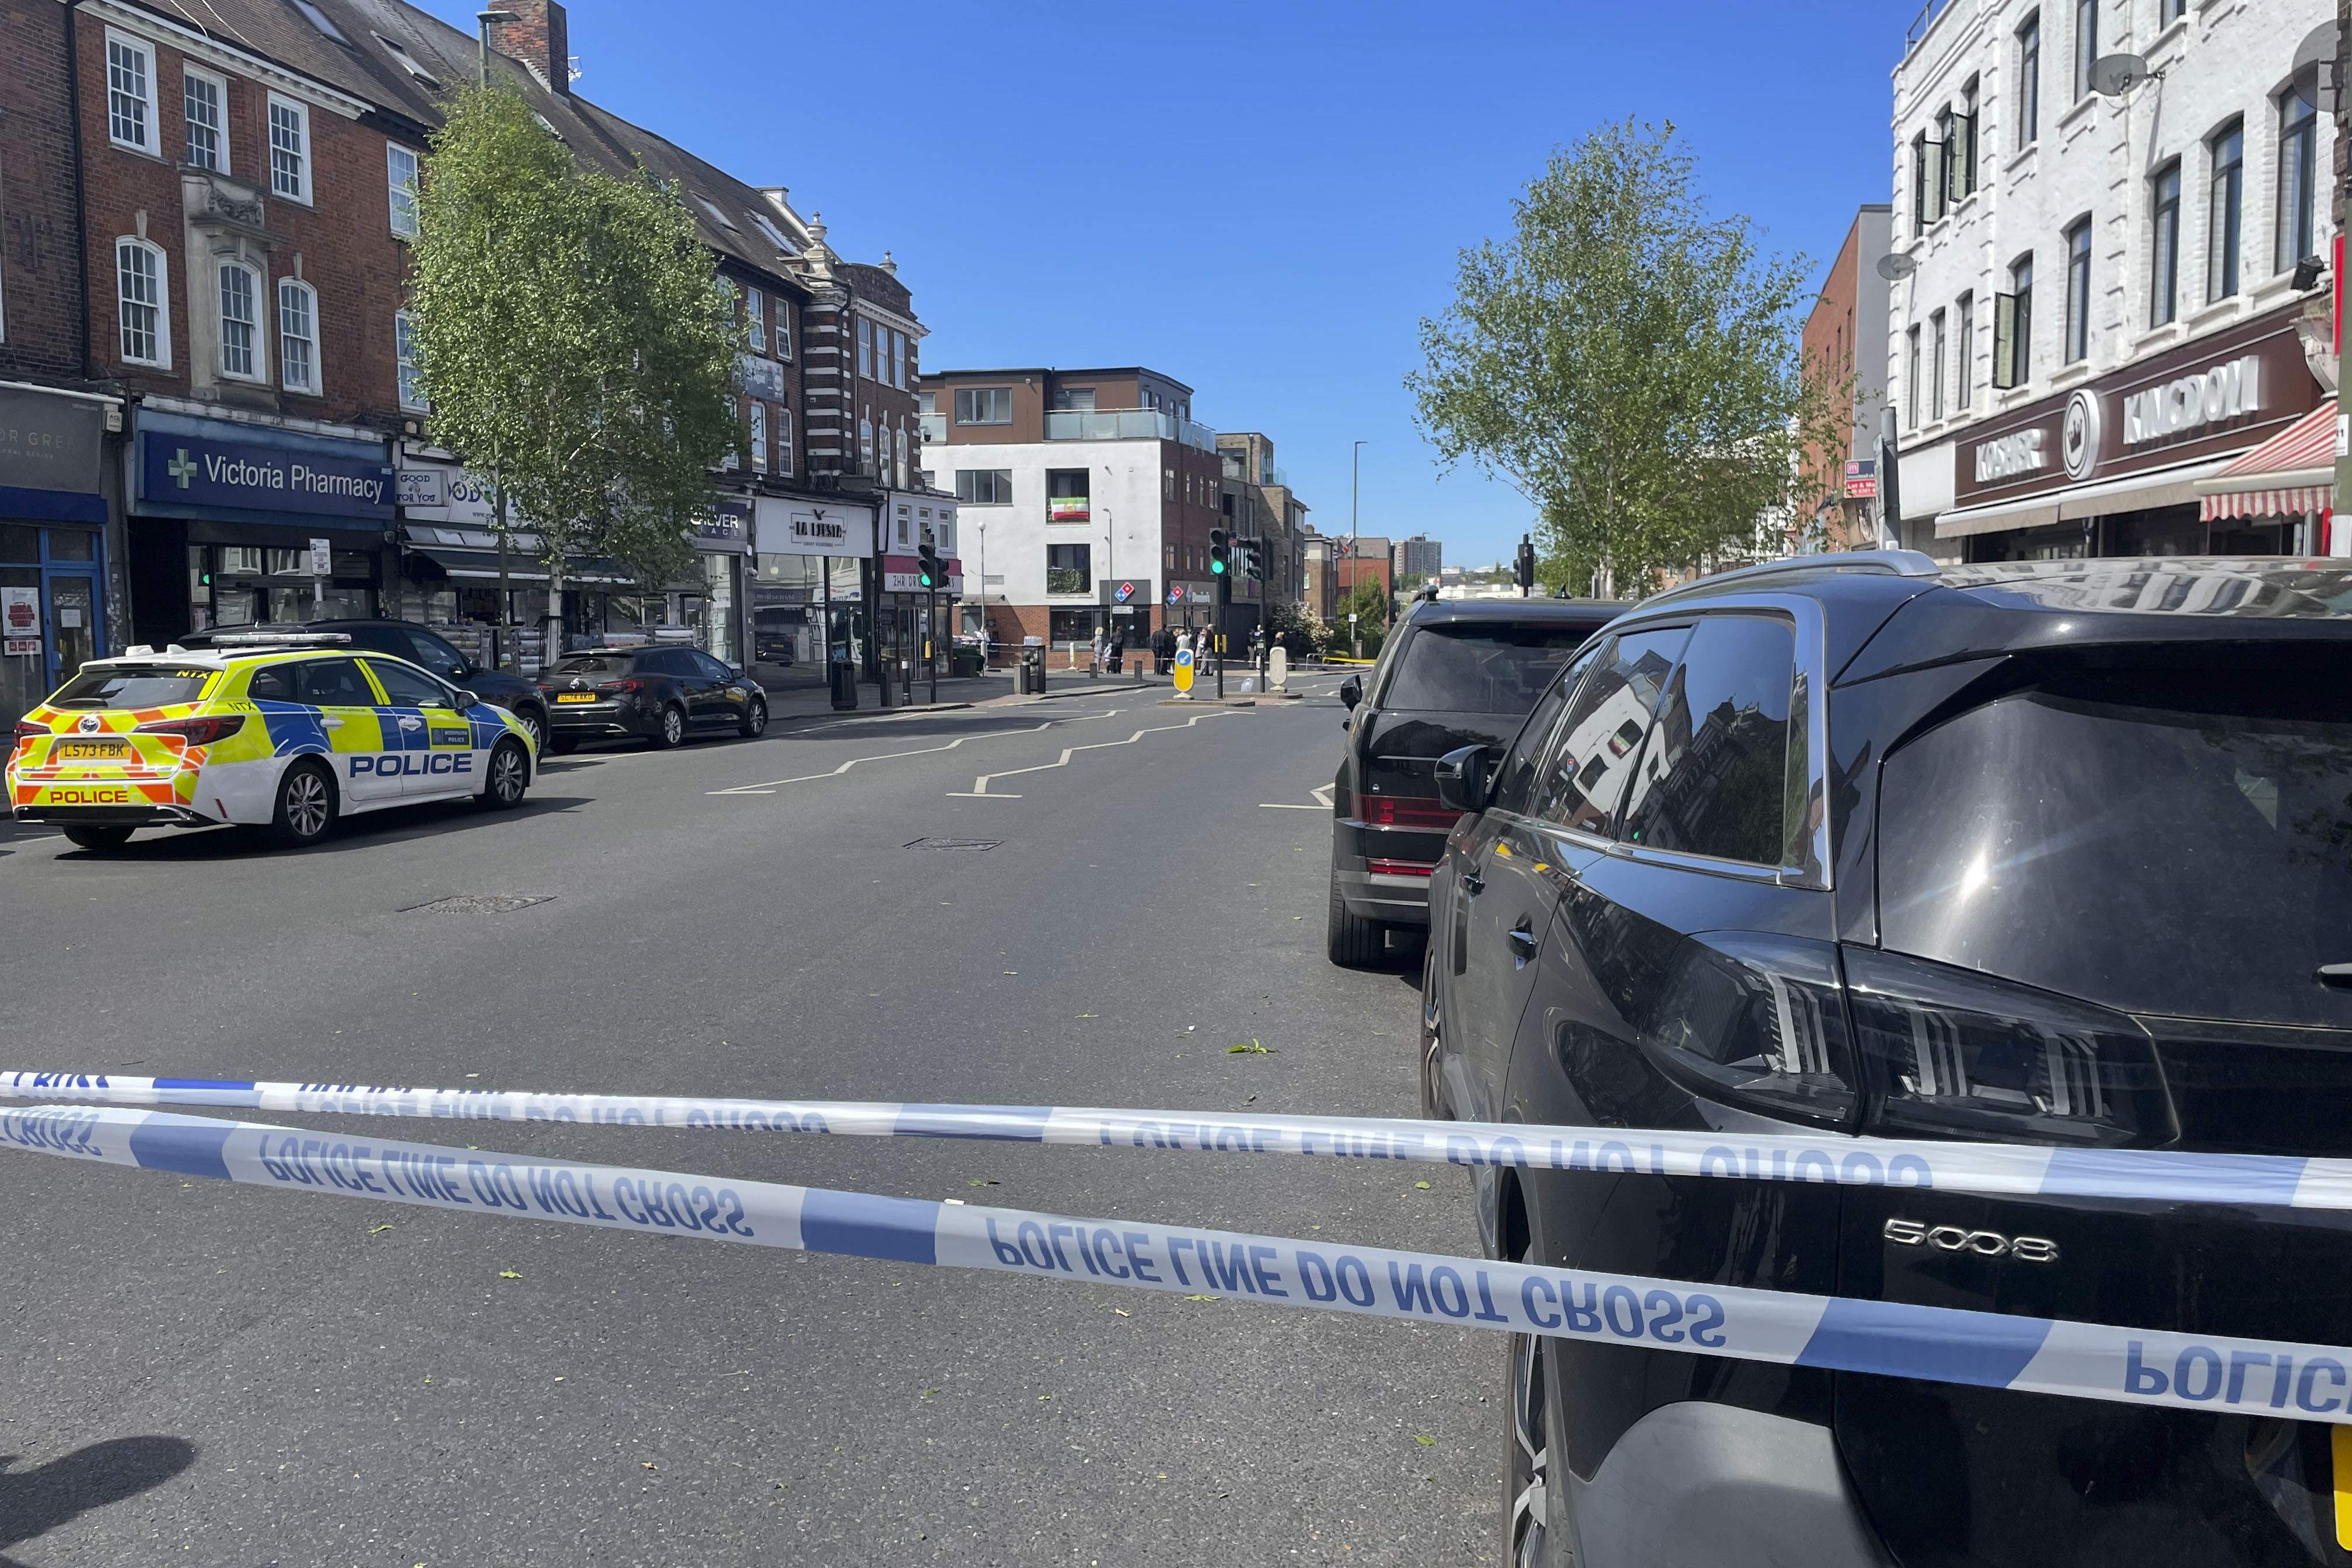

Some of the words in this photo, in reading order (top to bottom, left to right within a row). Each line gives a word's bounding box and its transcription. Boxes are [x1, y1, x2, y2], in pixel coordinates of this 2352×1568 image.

[1976, 429, 2042, 482] KOSHER
[2123, 355, 2260, 445] KINGDOM
[204, 454, 284, 490] Victoria
[292, 464, 383, 505] Pharmacy
[396, 494, 414, 503] FOR
[417, 494, 435, 503] YOU
[893, 575, 905, 587] 2HR
[228, 702, 257, 711] NTX
[65, 744, 96, 757] LS73
[100, 743, 124, 757] FBK
[350, 754, 472, 778] POLICE
[50, 790, 128, 804] POLICE
[1883, 1218, 2060, 1262] 5008
